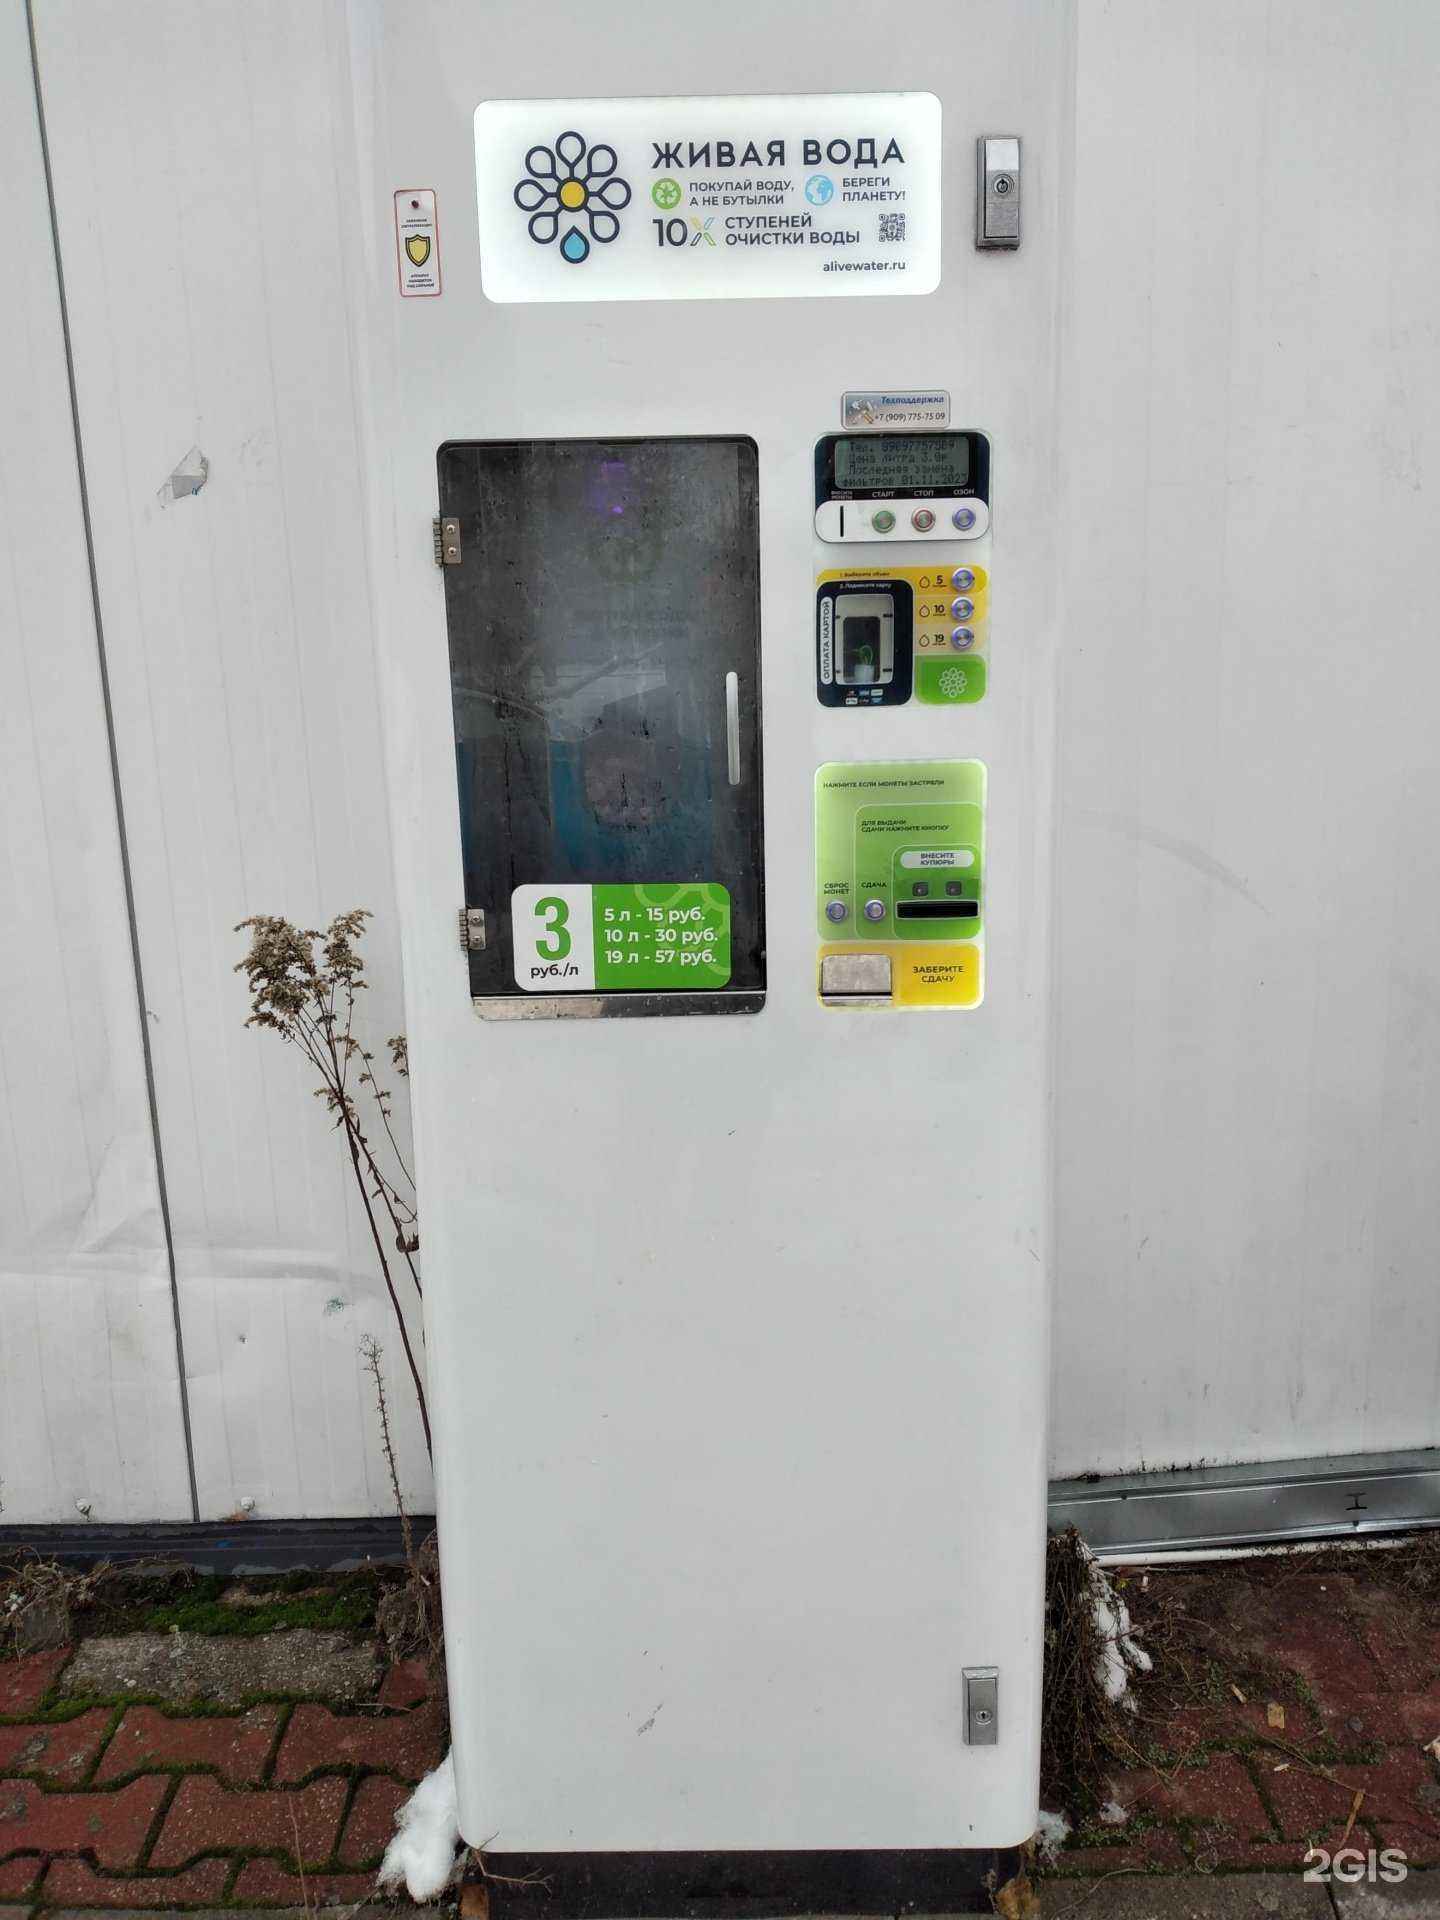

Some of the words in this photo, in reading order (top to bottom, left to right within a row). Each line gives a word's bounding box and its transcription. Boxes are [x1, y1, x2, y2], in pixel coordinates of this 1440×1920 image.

[651, 140, 785, 168] ЖИВАЯ
[803, 137, 905, 169] ВОДА
[689, 180, 752, 192] ПОКУПАЙ
[756, 180, 794, 192] ВОДУ,
[842, 177, 890, 188] БЕРЕГИ
[689, 197, 699, 206] А
[702, 196, 719, 206] НЕ
[722, 195, 784, 206] БУТЫЛКИ
[842, 191, 906, 202] ПЛАНЕТУ!
[725, 212, 812, 229] СТУПЕНЕЙ
[725, 232, 804, 246] ОЧИСТКИ
[810, 231, 860, 246] ВОДЫ
[823, 260, 906, 272] alivewater.ru
[886, 413, 906, 422] (909)
[936, 575, 944, 584] 5
[934, 604, 945, 614] 10
[822, 601, 830, 638] КАРТОЙ
[934, 634, 945, 642] 19
[822, 640, 830, 680] ОПЛАТА
[604, 908, 615, 922] 5
[619, 910, 631, 921] л
[646, 907, 664, 920] 15
[668, 906, 706, 924] руб.
[534, 897, 572, 961] 3
[605, 929, 624, 942] 10
[628, 930, 639, 942] л
[655, 929, 676, 942] 30
[682, 928, 718, 945] руб.
[605, 950, 624, 964] 19
[628, 952, 639, 964] л
[655, 950, 675, 963] 57
[680, 949, 717, 966] руб.
[530, 962, 579, 978] руб./л
[913, 964, 964, 974] ЗАБЕРИТЕ
[921, 974, 955, 983] СДАЧУ
